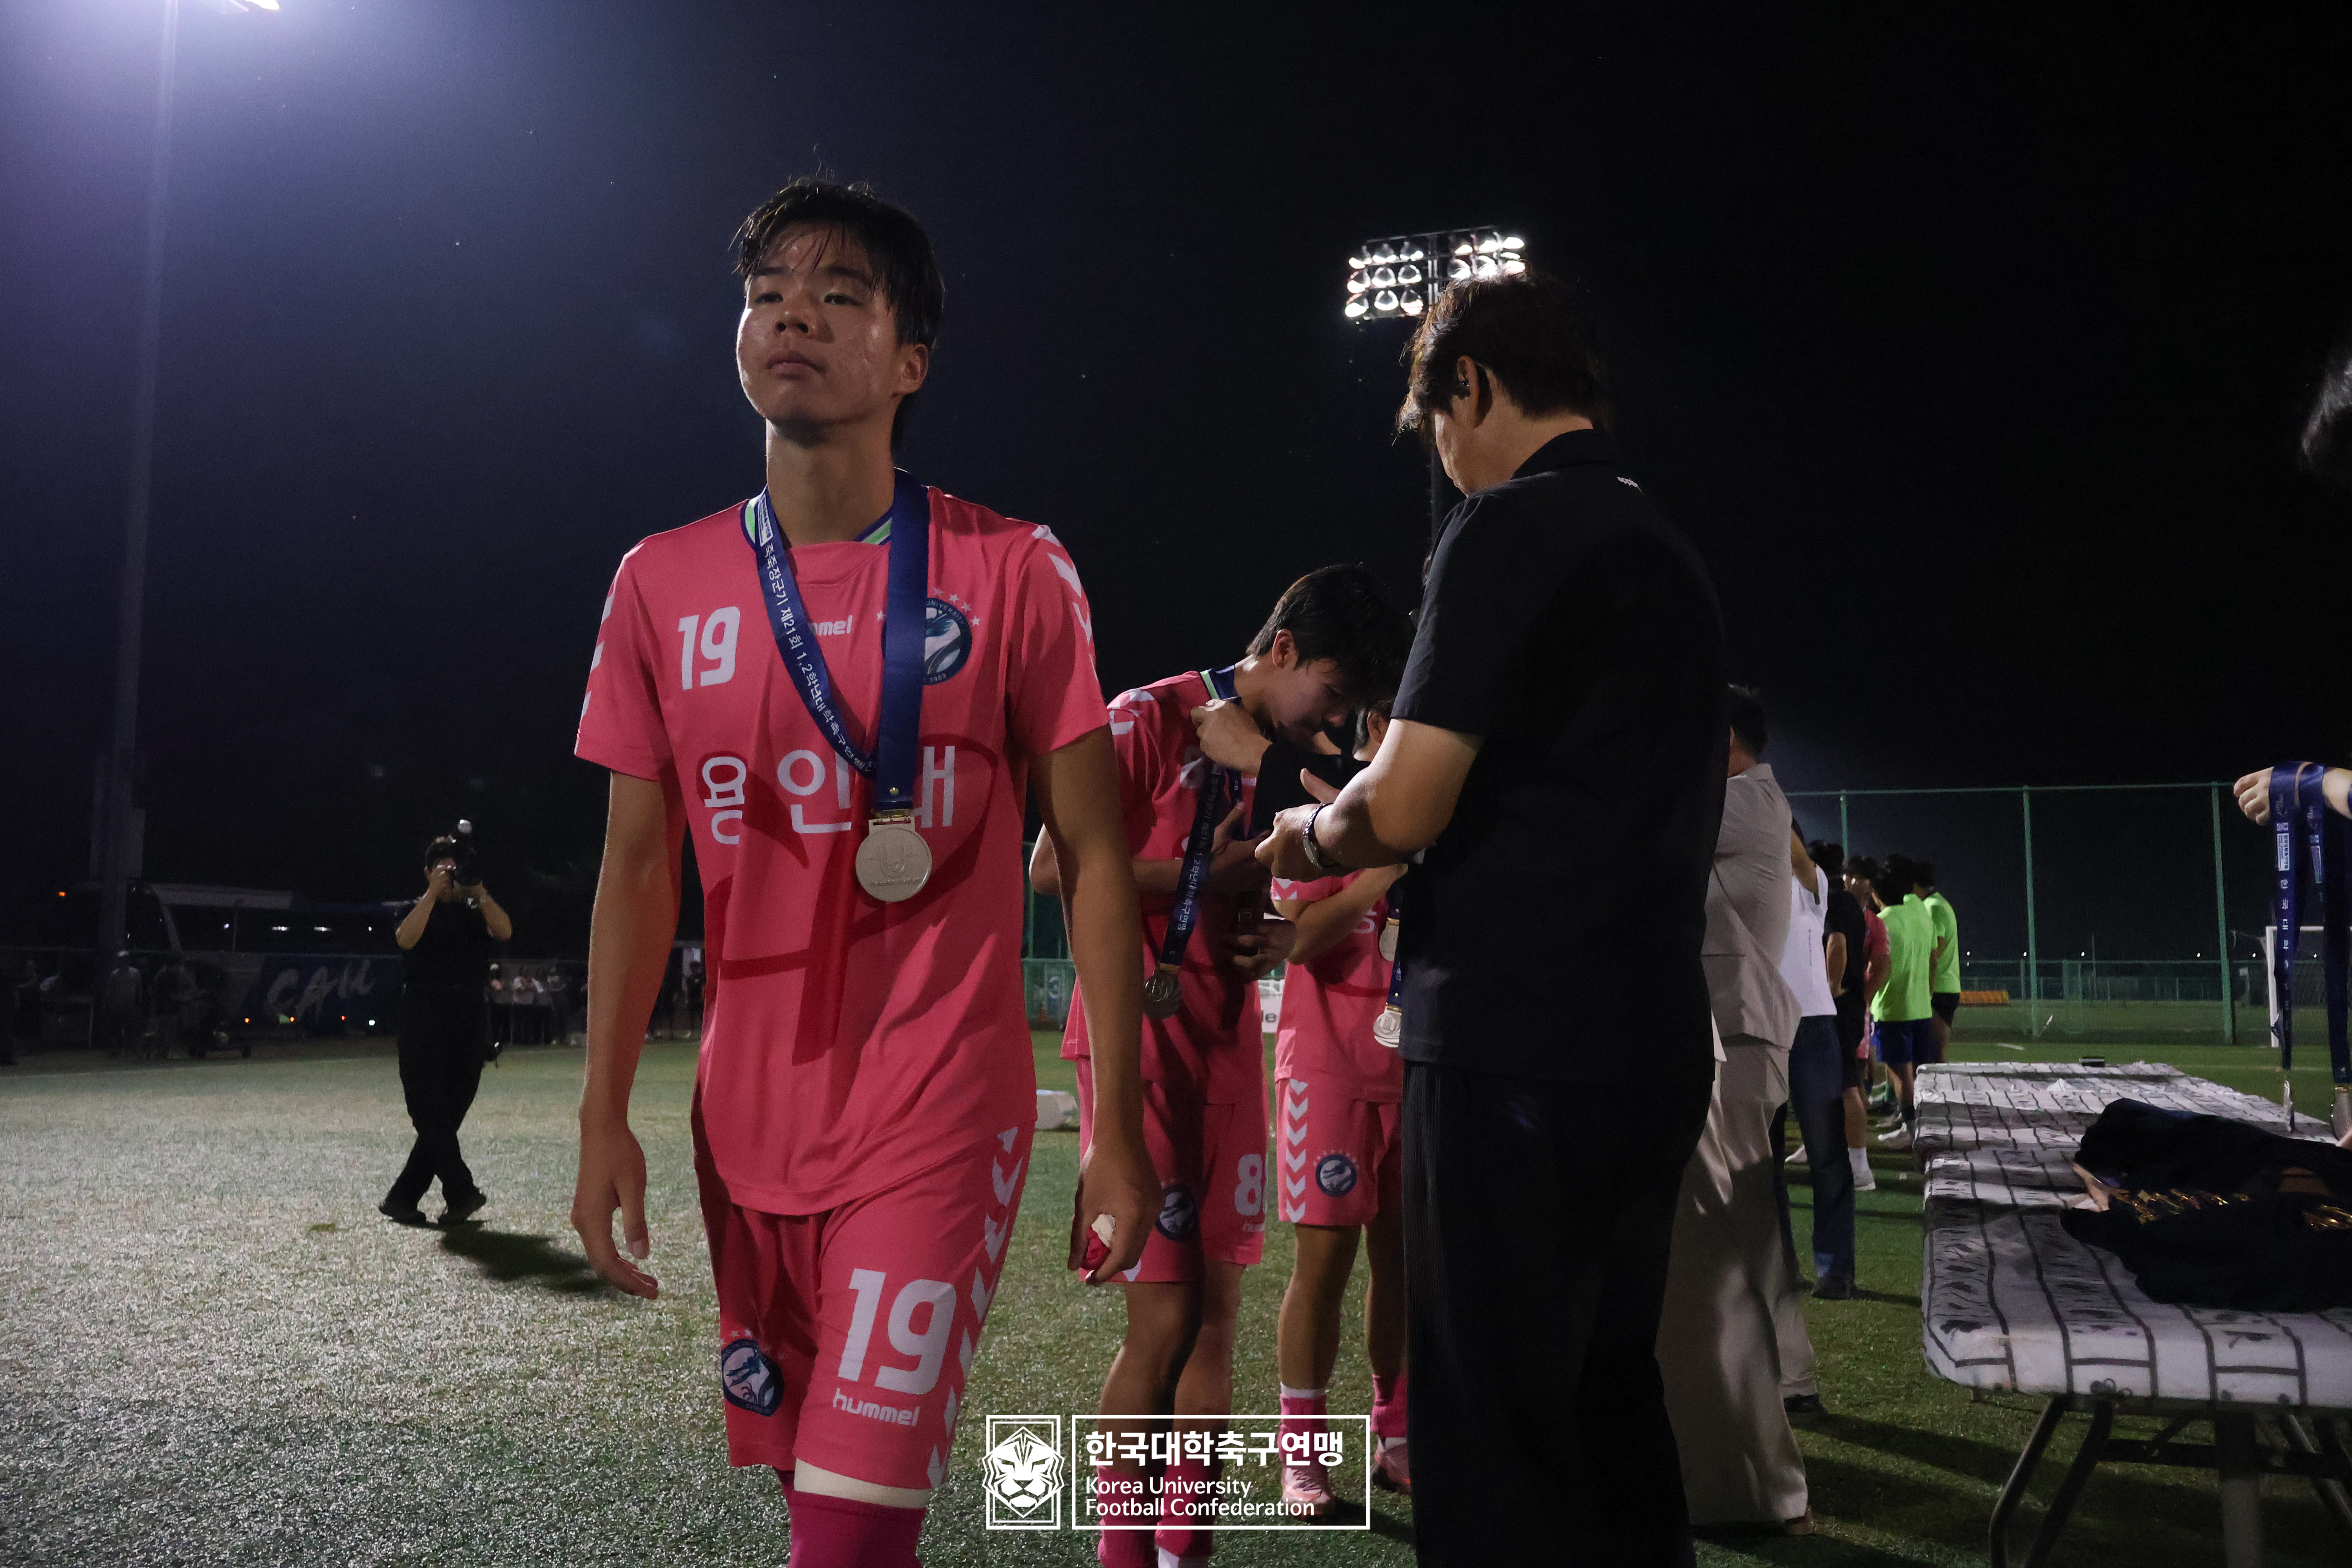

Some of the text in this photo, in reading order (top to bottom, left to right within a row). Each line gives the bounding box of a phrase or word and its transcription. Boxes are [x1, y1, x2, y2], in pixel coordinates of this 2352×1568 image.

[764, 543, 789, 606] 죽죽장군기
[780, 607, 804, 650] 제21회
[678, 606, 740, 690] 19
[838, 1268, 957, 1395] 19
[832, 1388, 920, 1427] hummel
